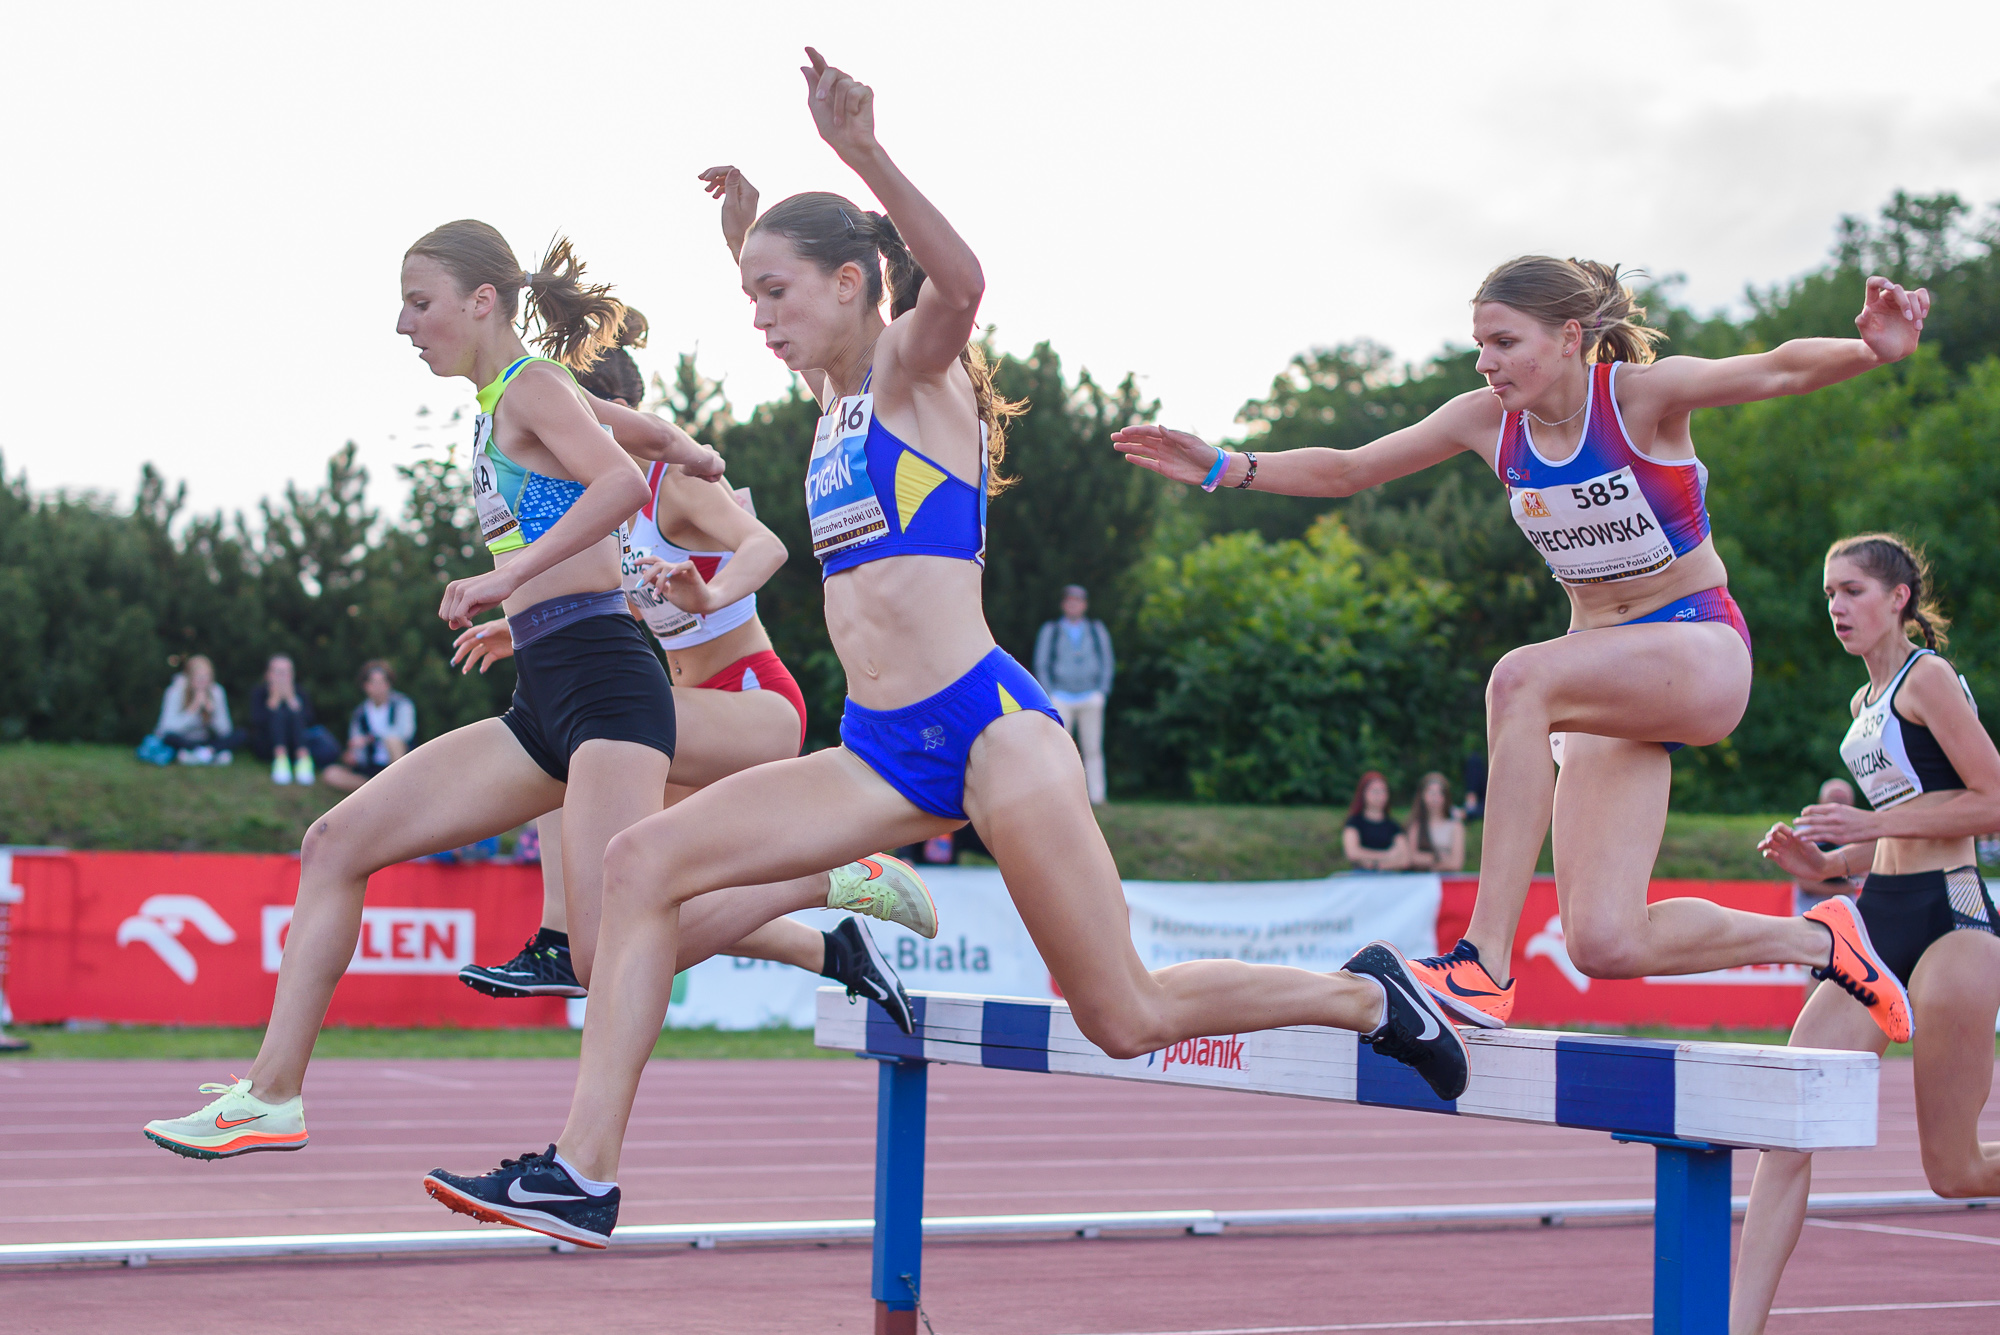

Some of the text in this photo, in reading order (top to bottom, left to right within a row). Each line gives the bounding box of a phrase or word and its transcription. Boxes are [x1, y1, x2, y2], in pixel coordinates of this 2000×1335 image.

[808, 454, 853, 505] CYGAN
[1507, 466, 1530, 481] esa
[1571, 474, 1629, 509] 585
[813, 521, 843, 537] Mistrzostwa
[843, 511, 866, 527] Polski
[865, 506, 881, 519] U18
[1527, 512, 1655, 552] PIECHOWSKA
[1577, 563, 1625, 575] Mistrzostwa
[1626, 555, 1652, 567] Polski
[1652, 545, 1669, 559] U18
[531, 598, 593, 627] SPORT
[1163, 1033, 1245, 1073] polanik
